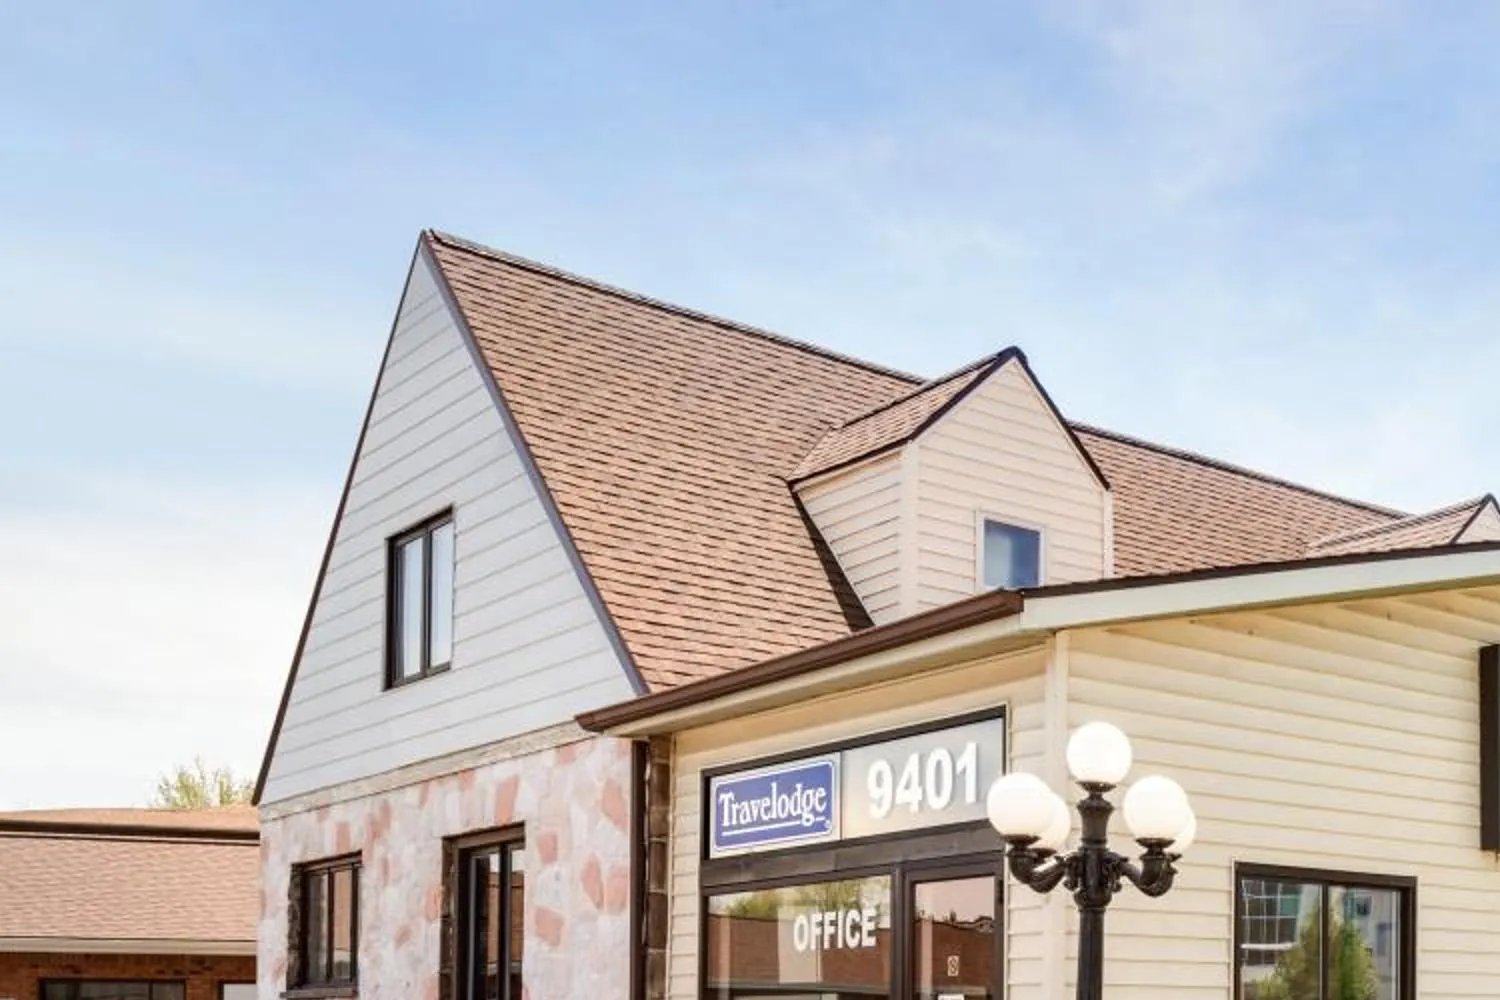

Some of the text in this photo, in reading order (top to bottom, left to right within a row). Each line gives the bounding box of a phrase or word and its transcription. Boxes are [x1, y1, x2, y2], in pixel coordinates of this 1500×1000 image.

[718, 781, 827, 826] Travelodge
[867, 741, 978, 820] 9401
[792, 906, 878, 952] OFFICE
